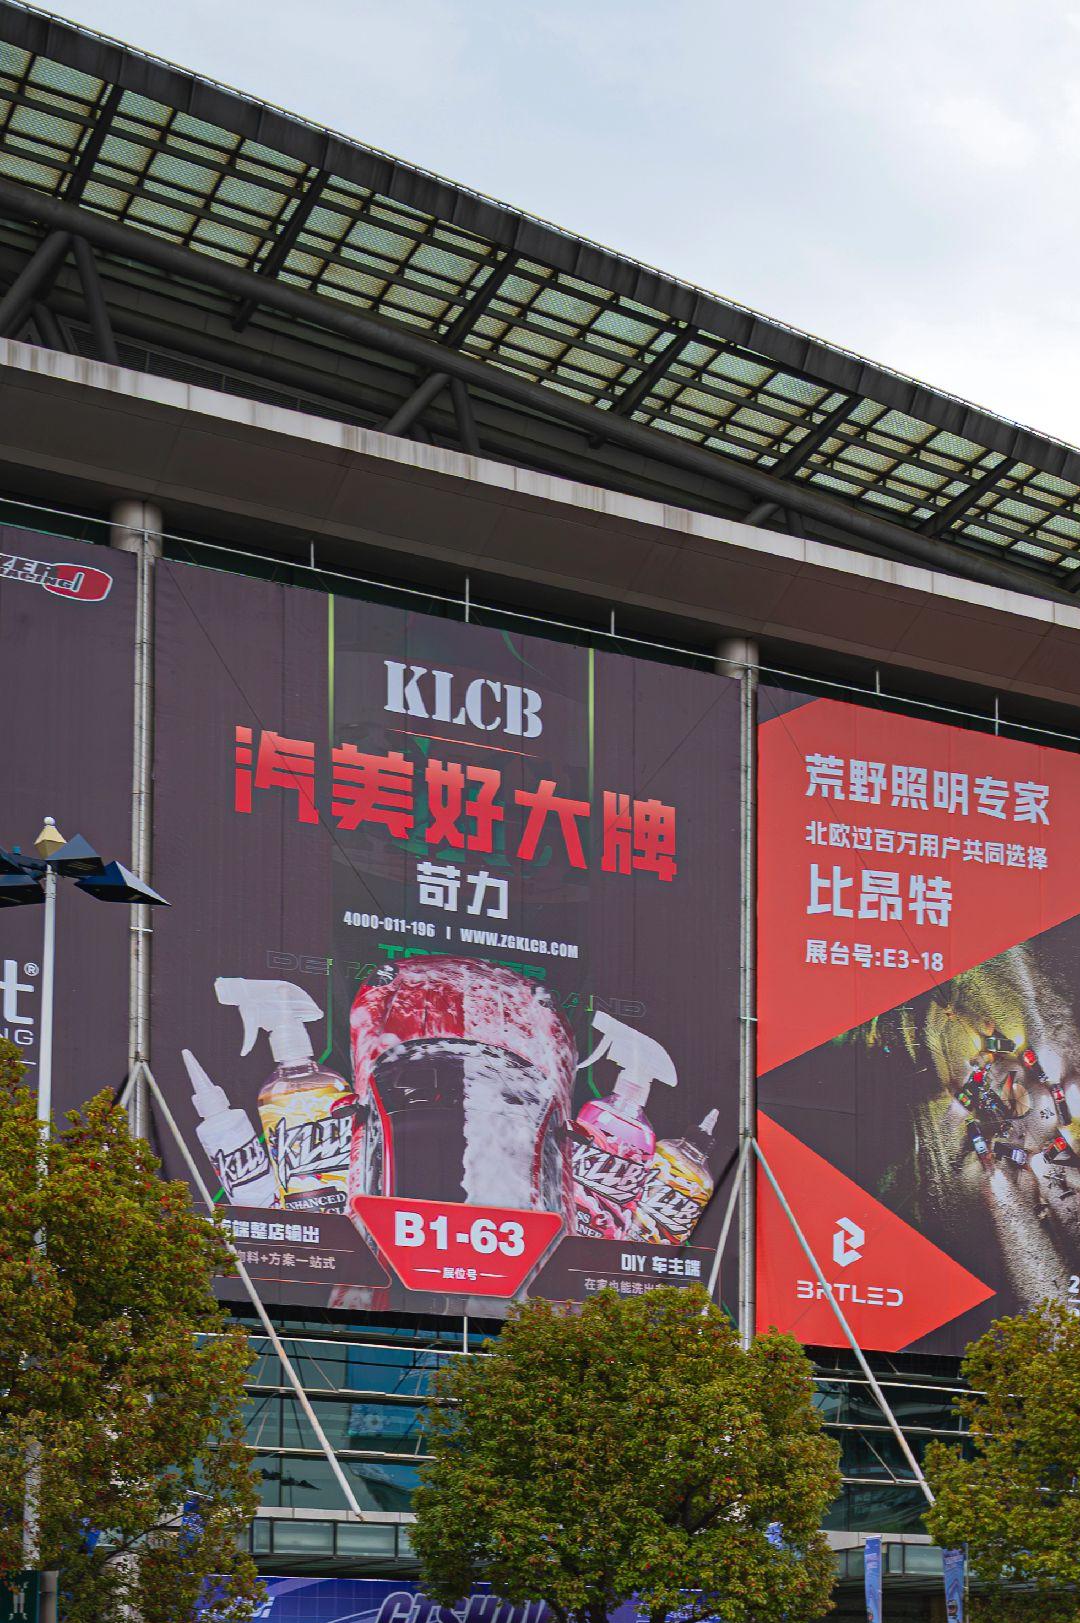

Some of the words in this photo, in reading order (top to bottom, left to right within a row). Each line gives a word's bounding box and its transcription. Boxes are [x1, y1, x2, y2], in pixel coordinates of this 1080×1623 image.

[384, 660, 543, 738] KLCB
[235, 725, 678, 882] 汽美好大牌
[805, 753, 1050, 825] 荒野照明专家
[806, 821, 1049, 870] 北欧过百万用户共同选择
[416, 861, 509, 920] 苛力
[807, 864, 953, 927] 比昂特
[343, 911, 436, 938] 4000-011-196
[459, 927, 580, 959] WWW.ZGKLCB.COM
[805, 939, 943, 972] 展台号:E3-18
[394, 1211, 525, 1257] B1-63
[442, 1267, 477, 1280] 展位号
[621, 1253, 648, 1273] DIY
[652, 1257, 701, 1277] 车主端
[796, 1280, 904, 1307] BRTLED
